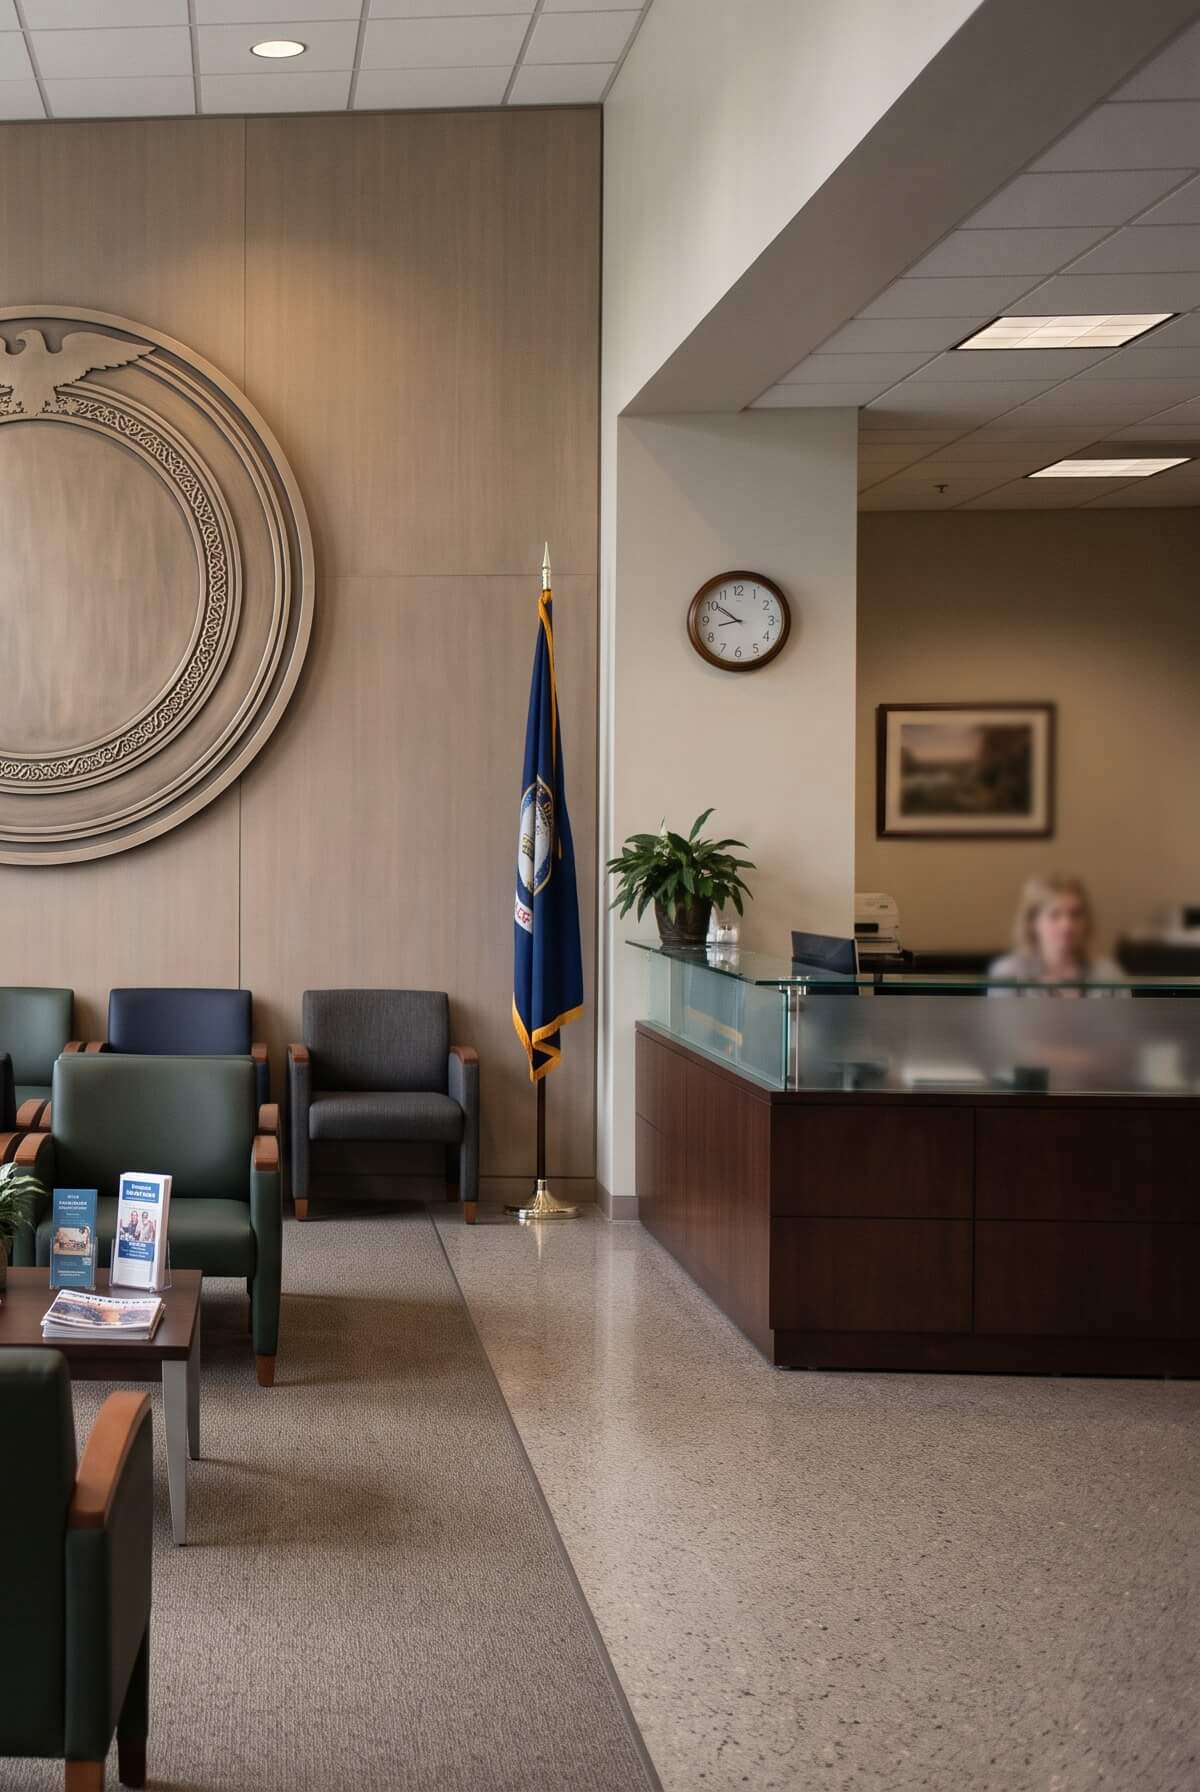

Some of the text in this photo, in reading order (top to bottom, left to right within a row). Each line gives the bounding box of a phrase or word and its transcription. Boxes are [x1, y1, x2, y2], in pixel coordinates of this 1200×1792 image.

[720, 590, 727, 601] 11
[733, 585, 744, 596] 12
[707, 601, 718, 611] 10
[763, 600, 770, 611] 2
[703, 616, 710, 626] 9
[768, 616, 775, 626] 3
[707, 632, 714, 643] 8
[763, 631, 769, 642] 4
[720, 643, 727, 653] 7
[734, 647, 742, 658] 6
[752, 643, 759, 654] 5
